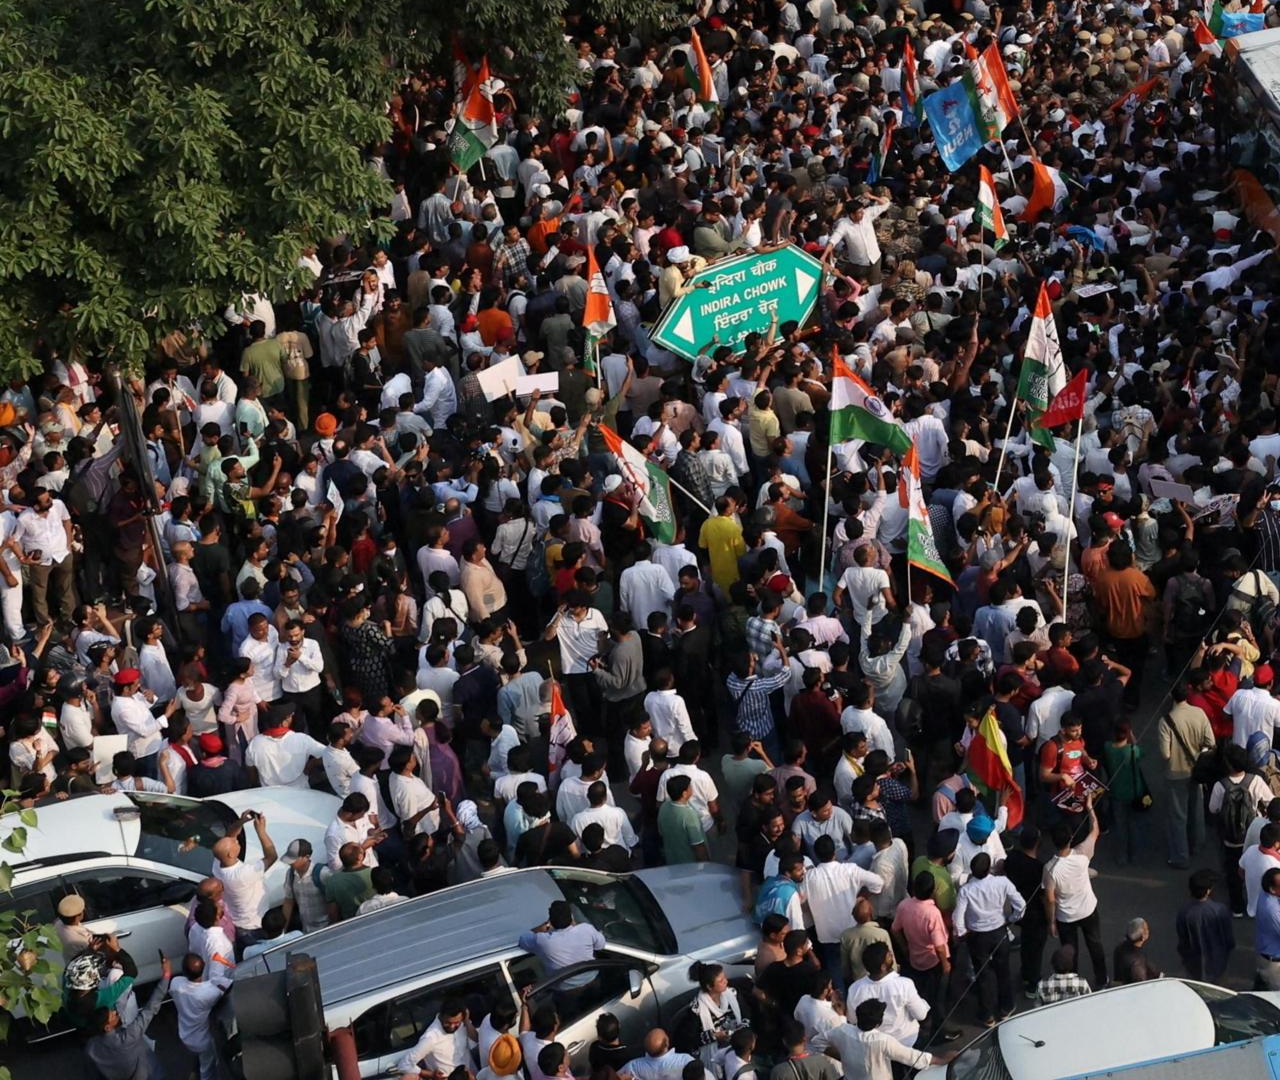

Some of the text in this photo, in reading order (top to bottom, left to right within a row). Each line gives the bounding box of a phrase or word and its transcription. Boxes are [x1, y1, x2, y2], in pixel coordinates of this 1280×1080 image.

[750, 259, 777, 276] चौक
[700, 275, 788, 316] INDIRA CHOWK
